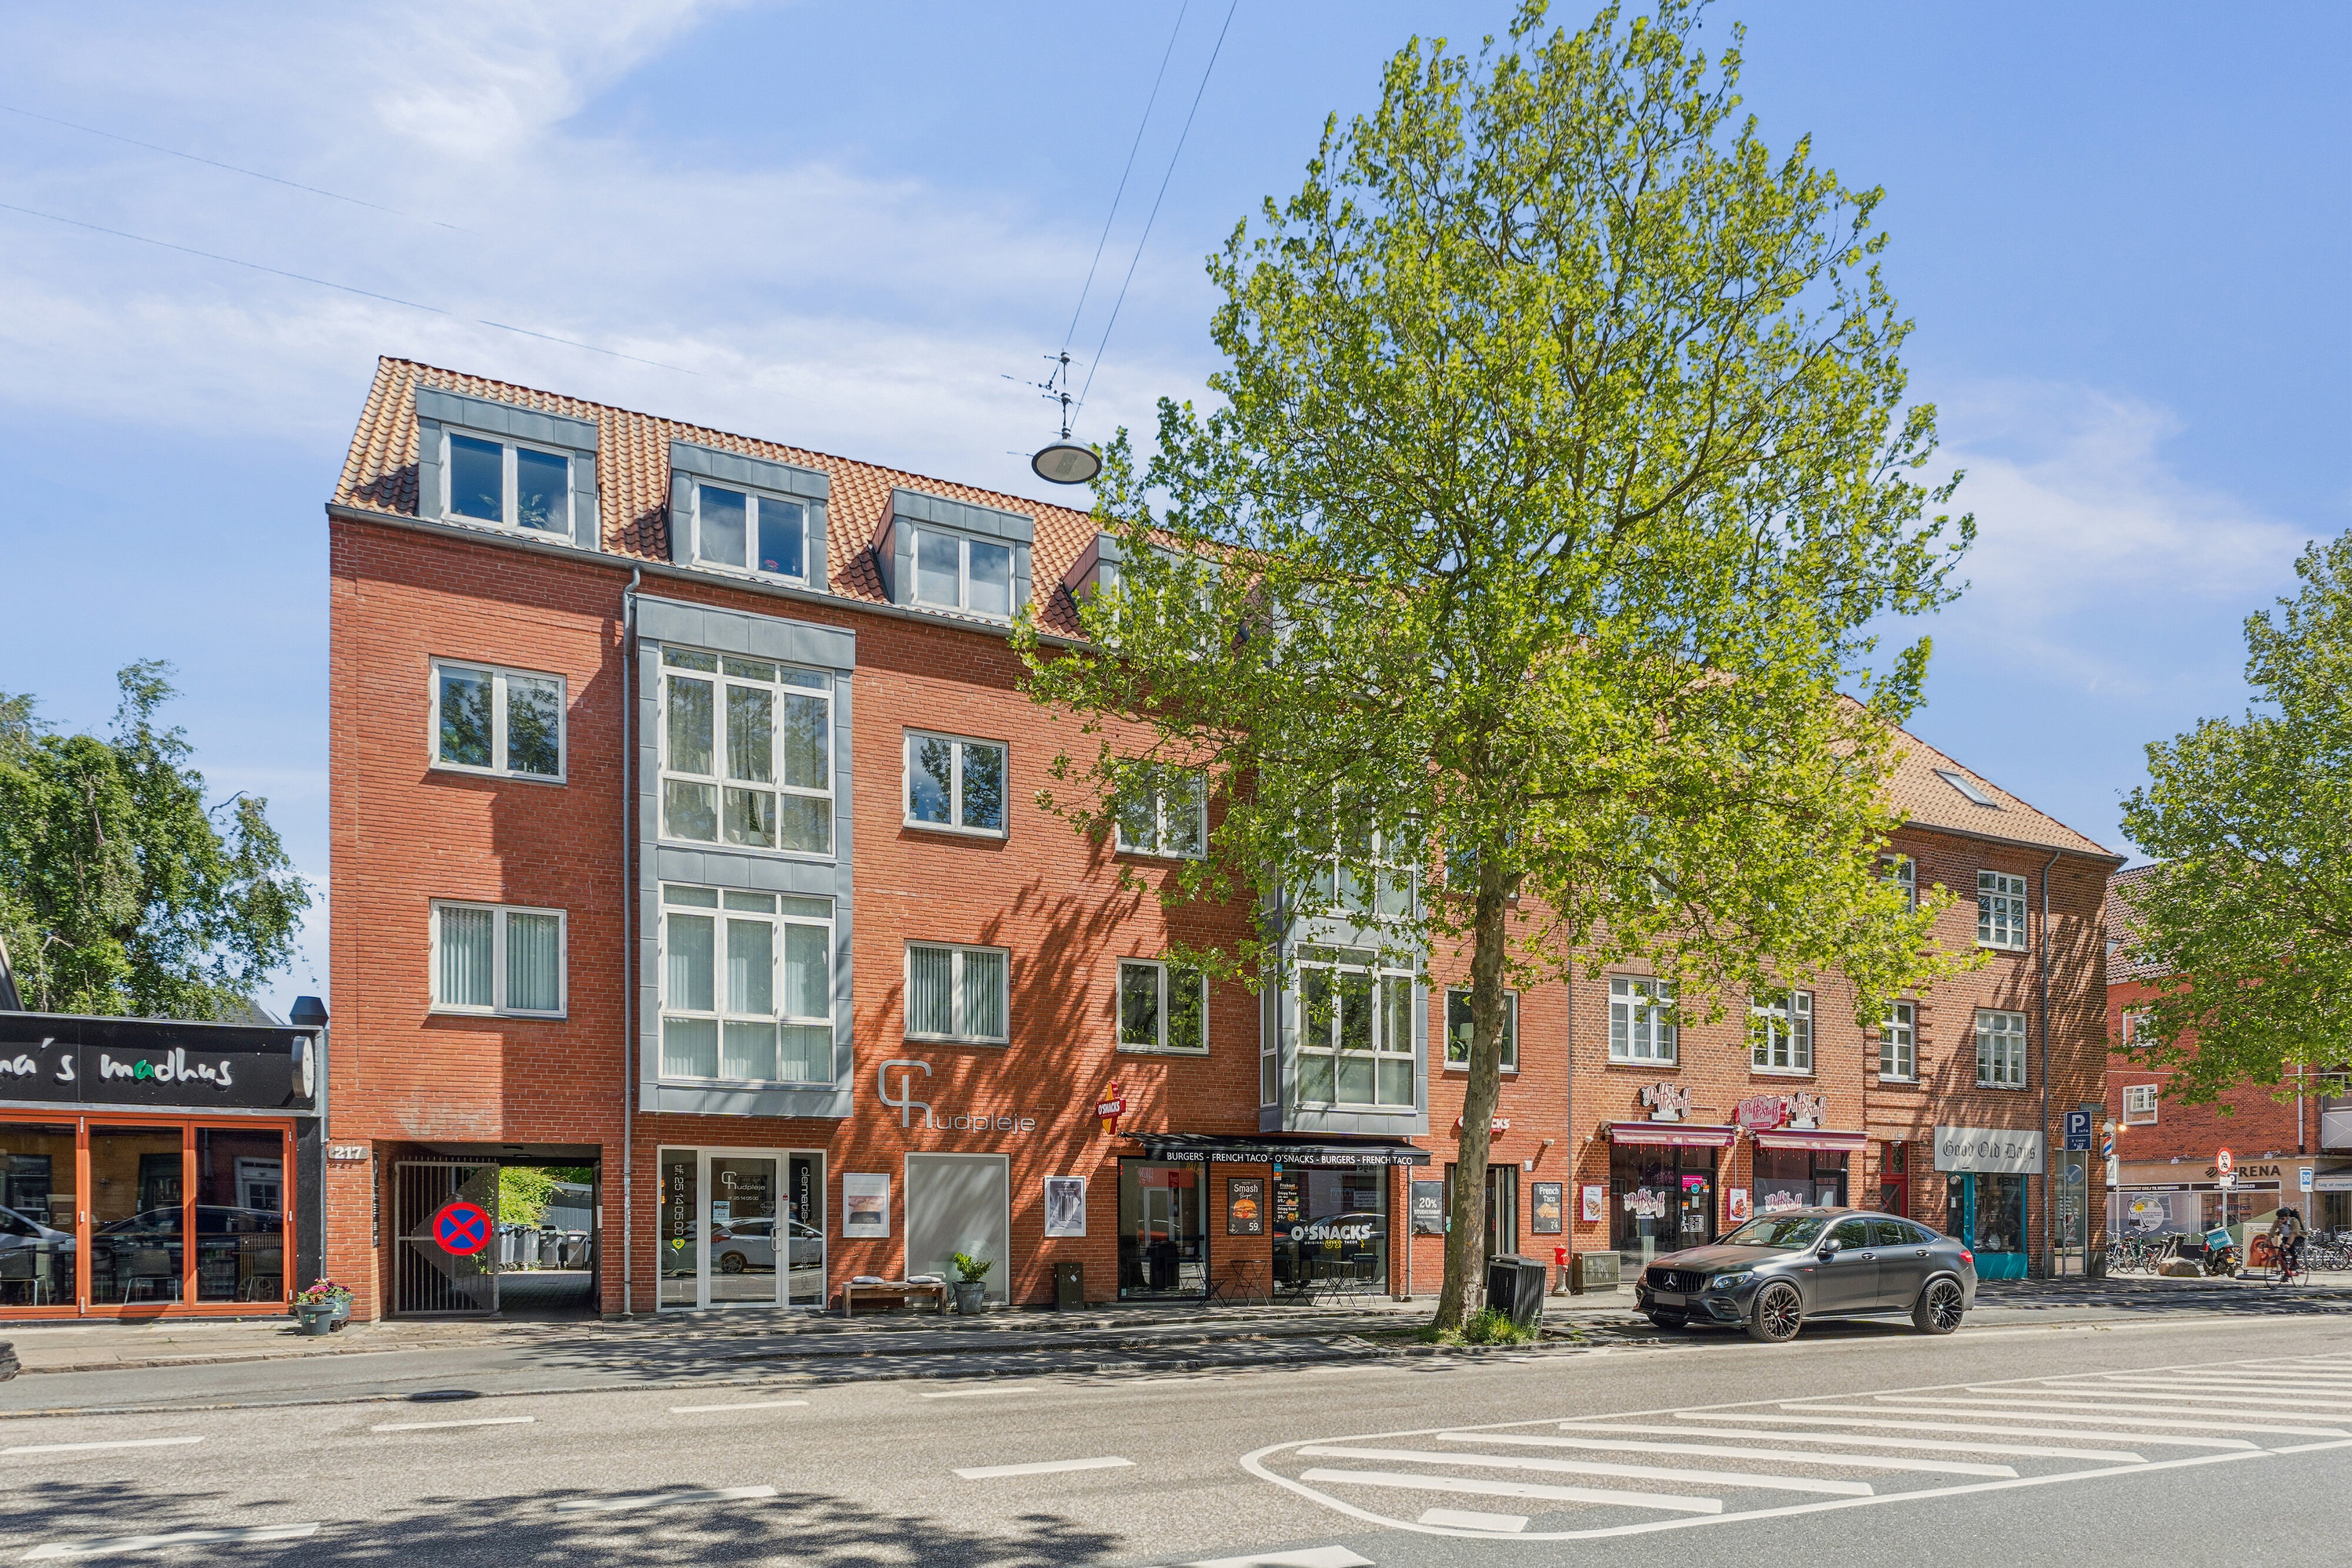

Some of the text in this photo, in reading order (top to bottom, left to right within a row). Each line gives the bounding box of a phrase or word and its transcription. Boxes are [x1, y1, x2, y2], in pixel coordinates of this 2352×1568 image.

[100, 1047, 233, 1087] madhus
[1642, 1082, 1669, 1111] Puff
[1668, 1087, 1692, 1117] Stuff
[1740, 1098, 1761, 1120] Puff
[1759, 1099, 1779, 1121] Stuff
[1805, 1096, 1827, 1125] Stuff
[2071, 1114, 2085, 1134] P
[334, 1145, 363, 1160] 217
[1167, 1152, 1204, 1161] BURGERS
[1212, 1153, 1243, 1162] FRENCH
[1321, 1156, 1356, 1164] BURGERS
[1362, 1156, 1391, 1165] FRENCH
[1392, 1156, 1413, 1165] TACO
[1943, 1140, 2037, 1162] Good Old Days
[674, 1177, 684, 1191] 25
[1233, 1184, 1258, 1192] Smash
[1539, 1186, 1559, 1196] French
[674, 1192, 684, 1205] 14
[1419, 1197, 1438, 1208] 20%
[674, 1206, 684, 1220] 05
[674, 1221, 684, 1236] 00
